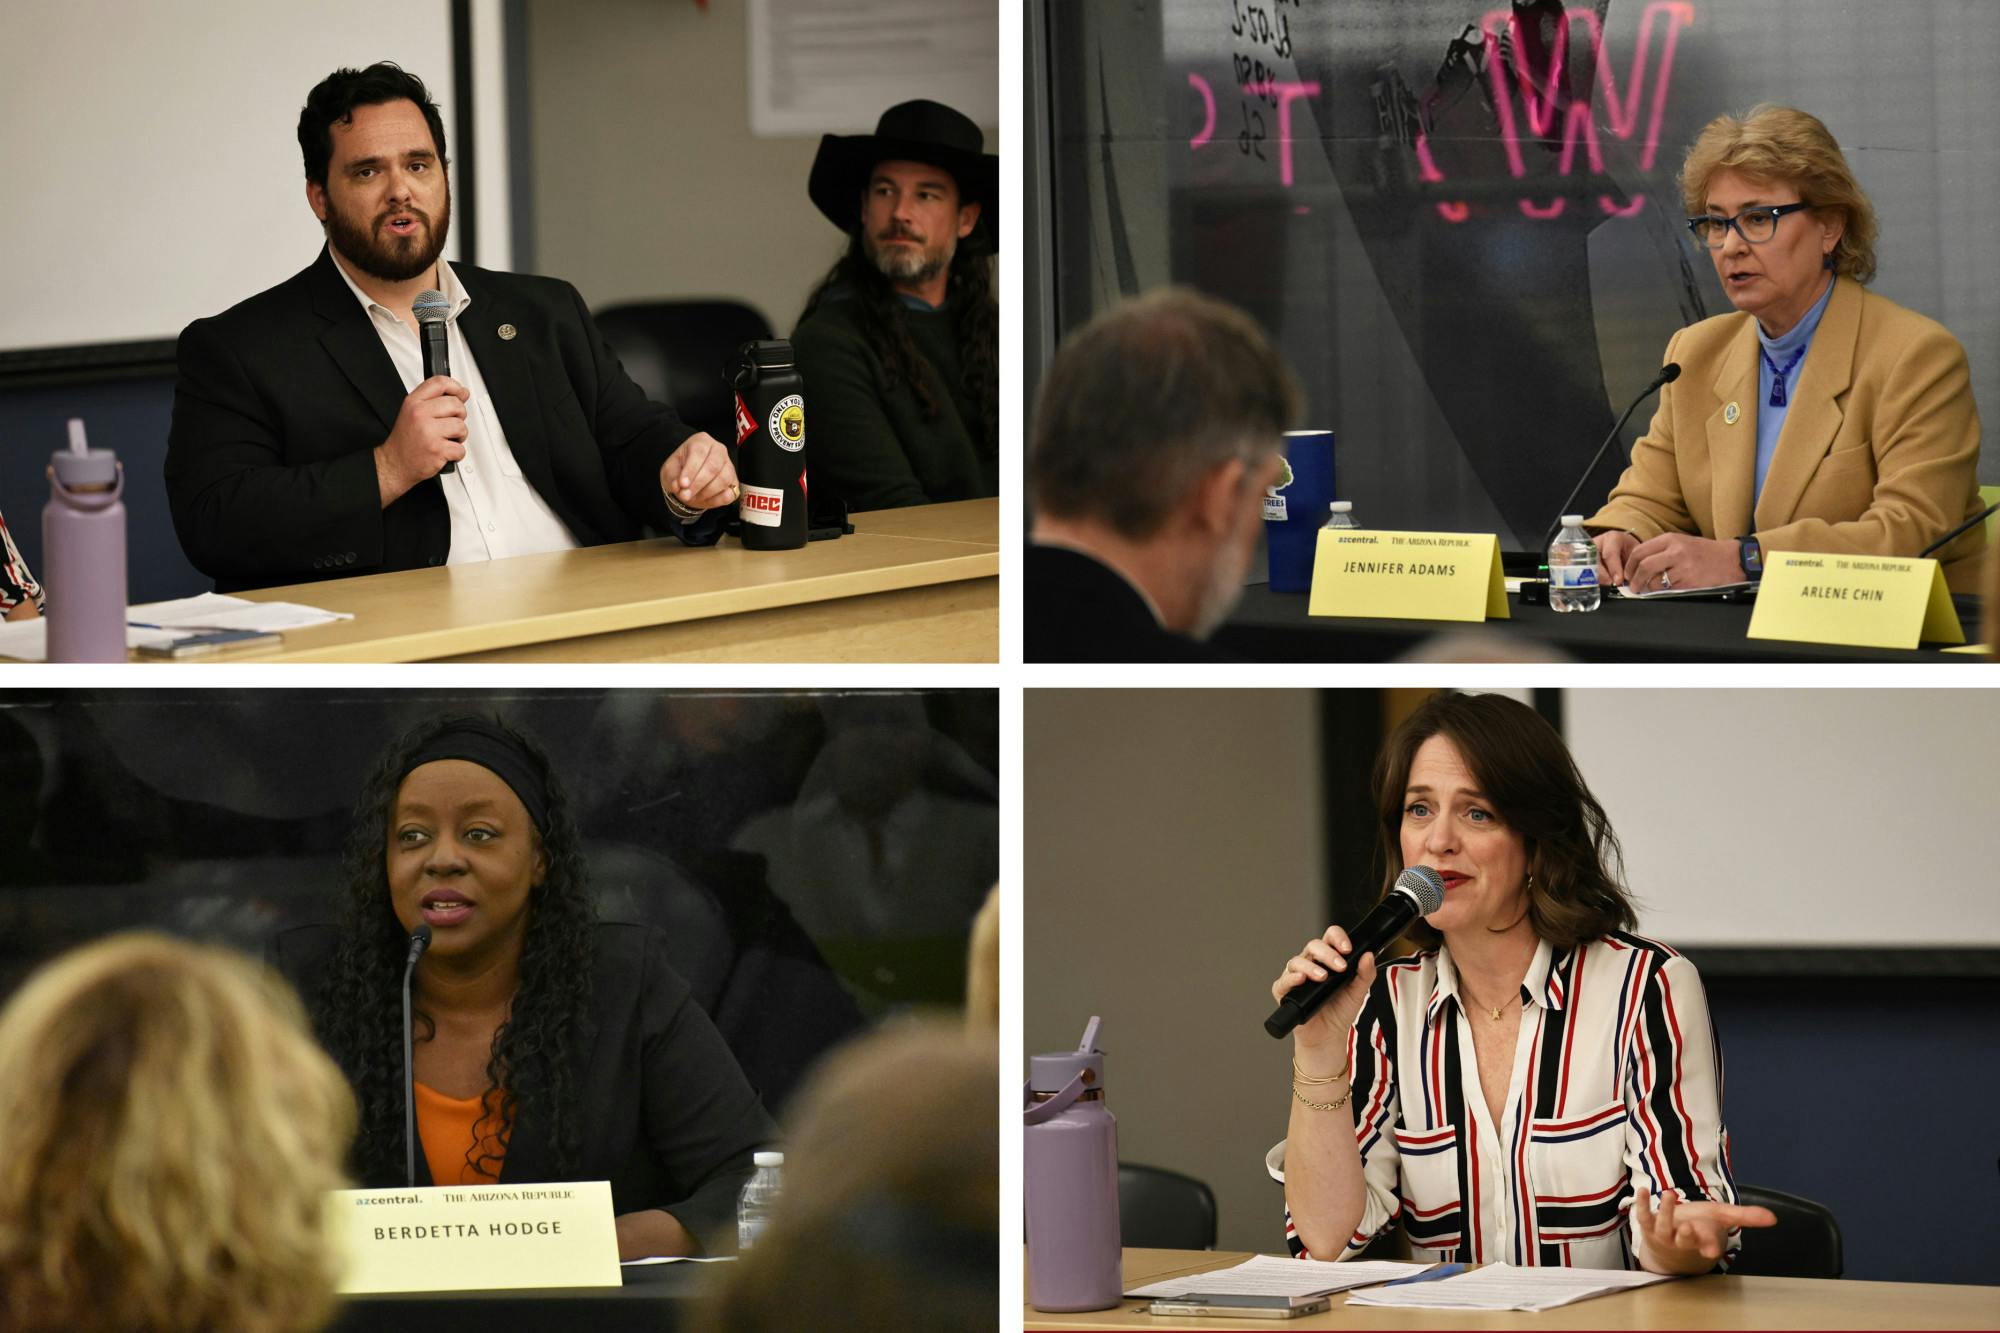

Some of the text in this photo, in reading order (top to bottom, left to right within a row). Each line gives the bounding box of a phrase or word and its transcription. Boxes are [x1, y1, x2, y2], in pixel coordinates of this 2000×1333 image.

[773, 400, 790, 418] ONLY
[773, 427, 794, 448] PREVENT
[1344, 561, 1455, 576] JENNIFER ADAMS
[1801, 585, 1884, 601] ARLENE CHIN
[443, 1194, 465, 1203] THE
[470, 1192, 518, 1202] ARIZONA
[520, 1190, 575, 1200] REPUBLIC
[374, 1221, 562, 1240] BERDETTA HODGE
